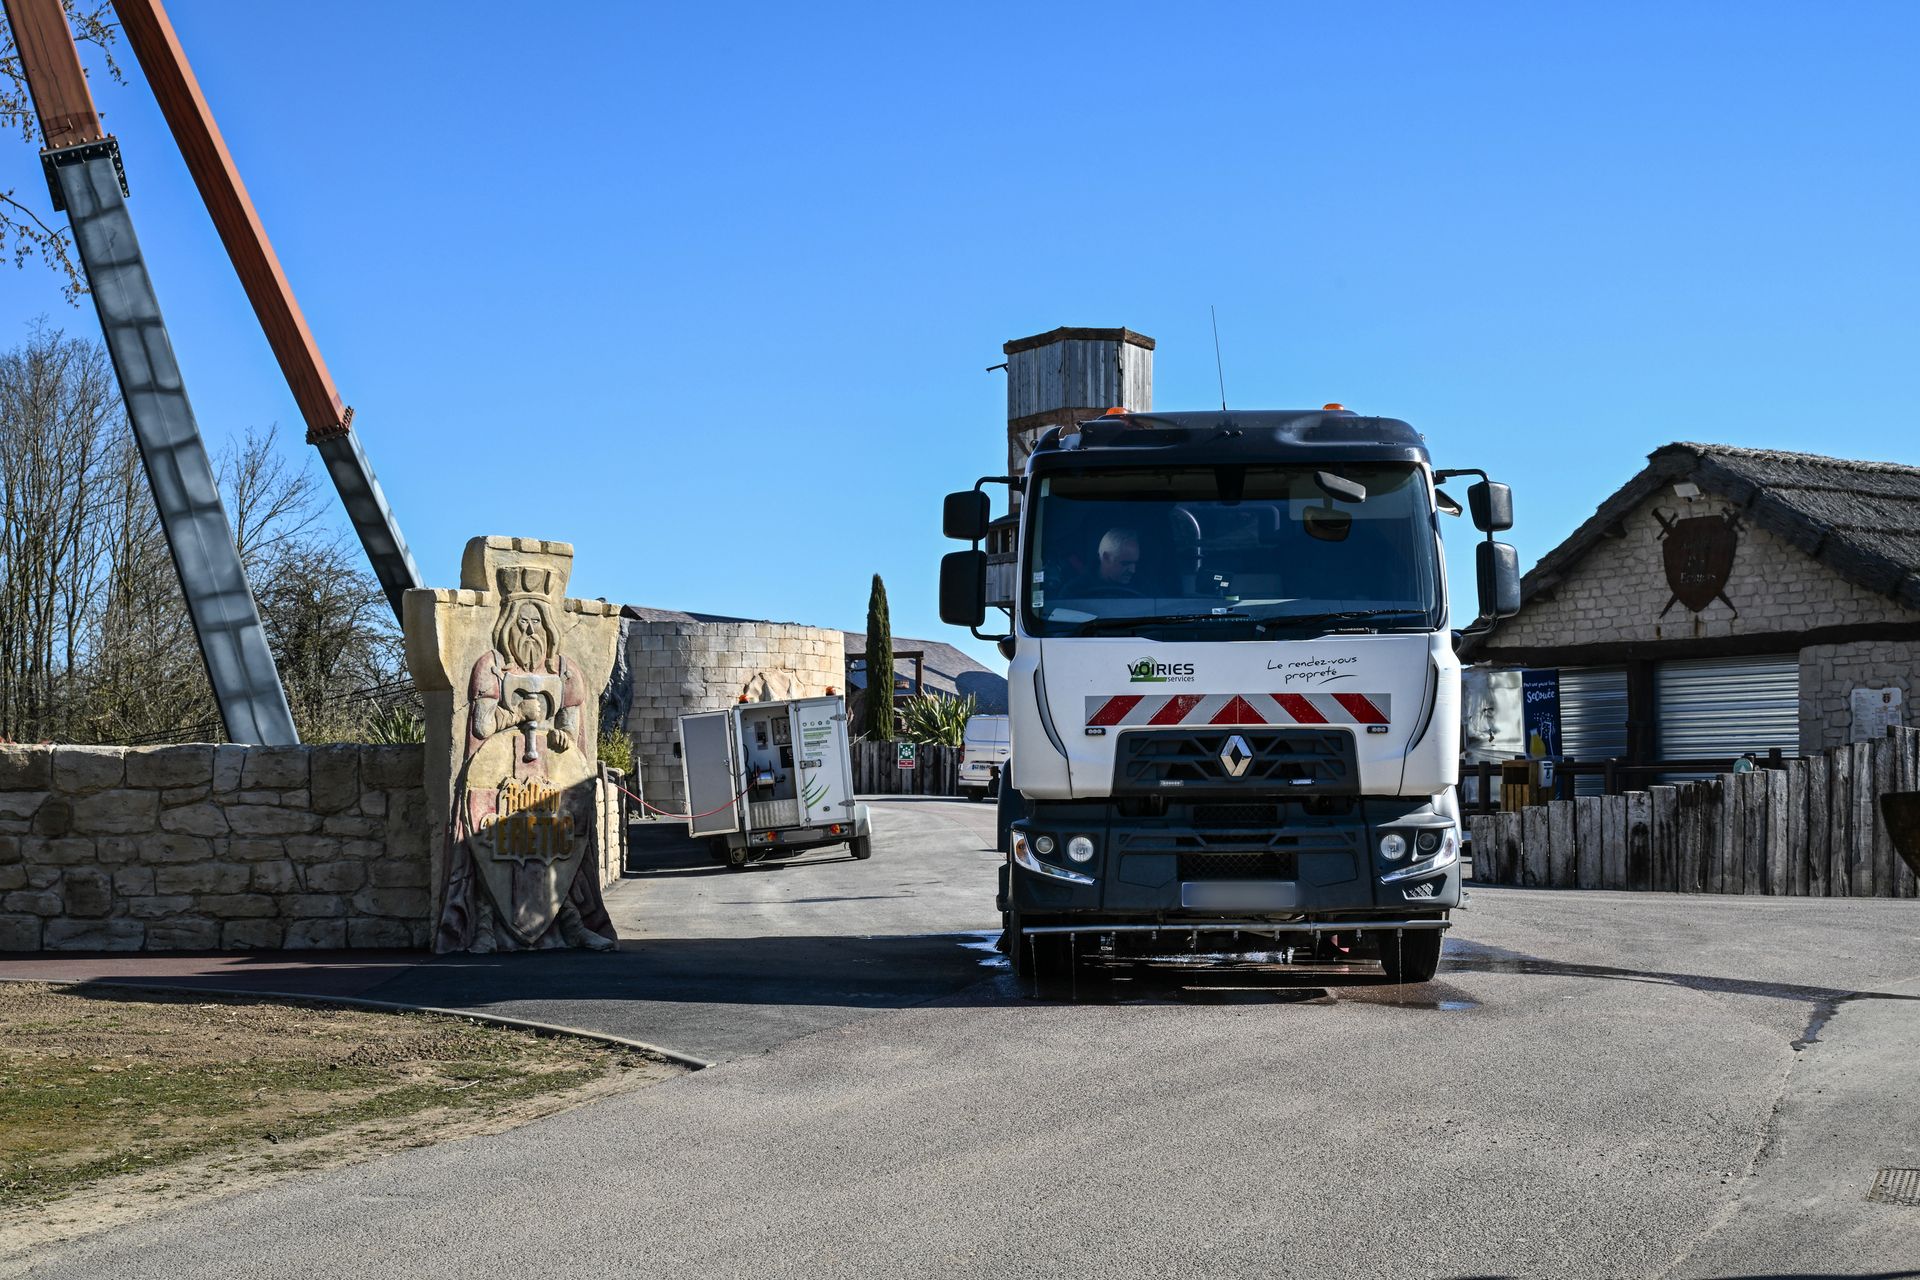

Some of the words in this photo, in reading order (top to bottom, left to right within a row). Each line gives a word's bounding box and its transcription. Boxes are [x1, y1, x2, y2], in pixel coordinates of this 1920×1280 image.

[1127, 663, 1195, 675] VOIRIES
[1267, 659, 1283, 670] Le
[1288, 655, 1357, 668] rendez-vous
[1285, 666, 1337, 684] propreté
